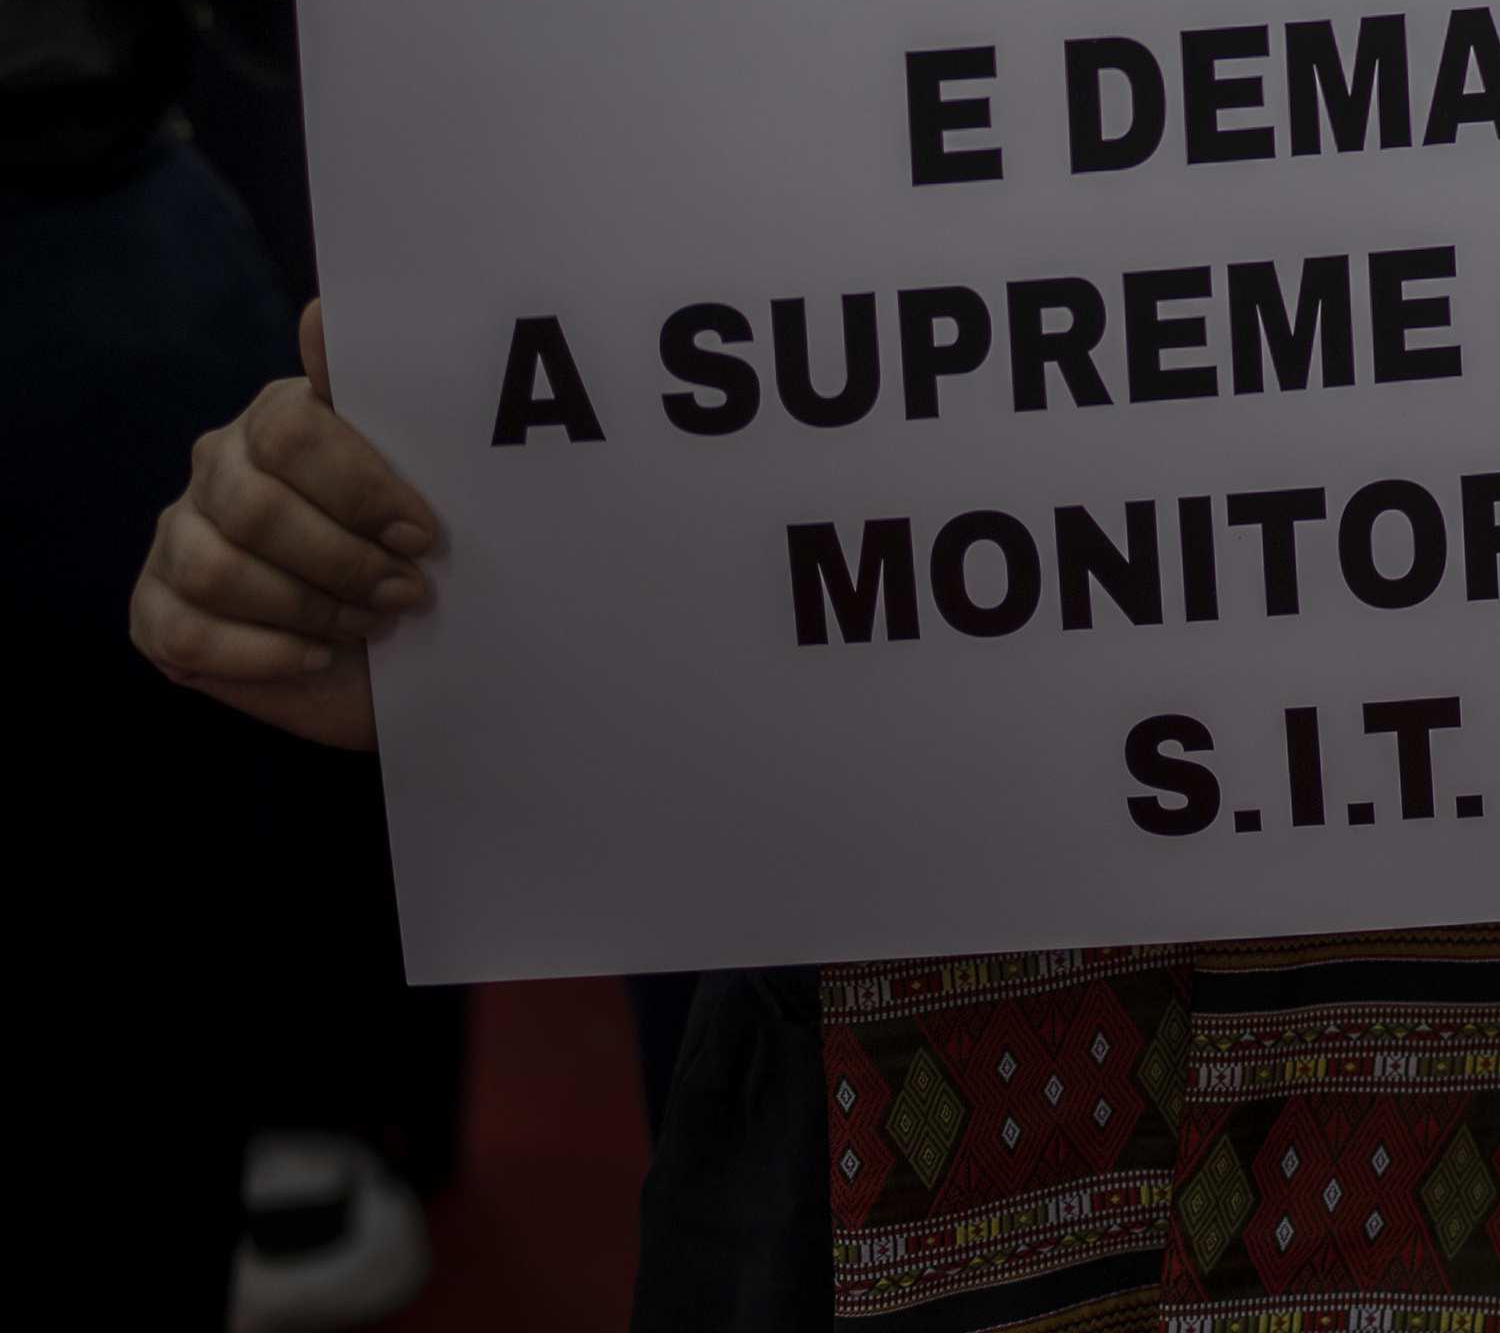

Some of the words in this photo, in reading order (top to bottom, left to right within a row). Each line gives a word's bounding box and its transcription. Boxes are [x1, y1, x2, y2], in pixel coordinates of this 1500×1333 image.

[905, 46, 1003, 186] E
[491, 315, 606, 448] A
[659, 246, 1462, 436] SUPREME
[1125, 696, 1483, 837] S.I.T.
